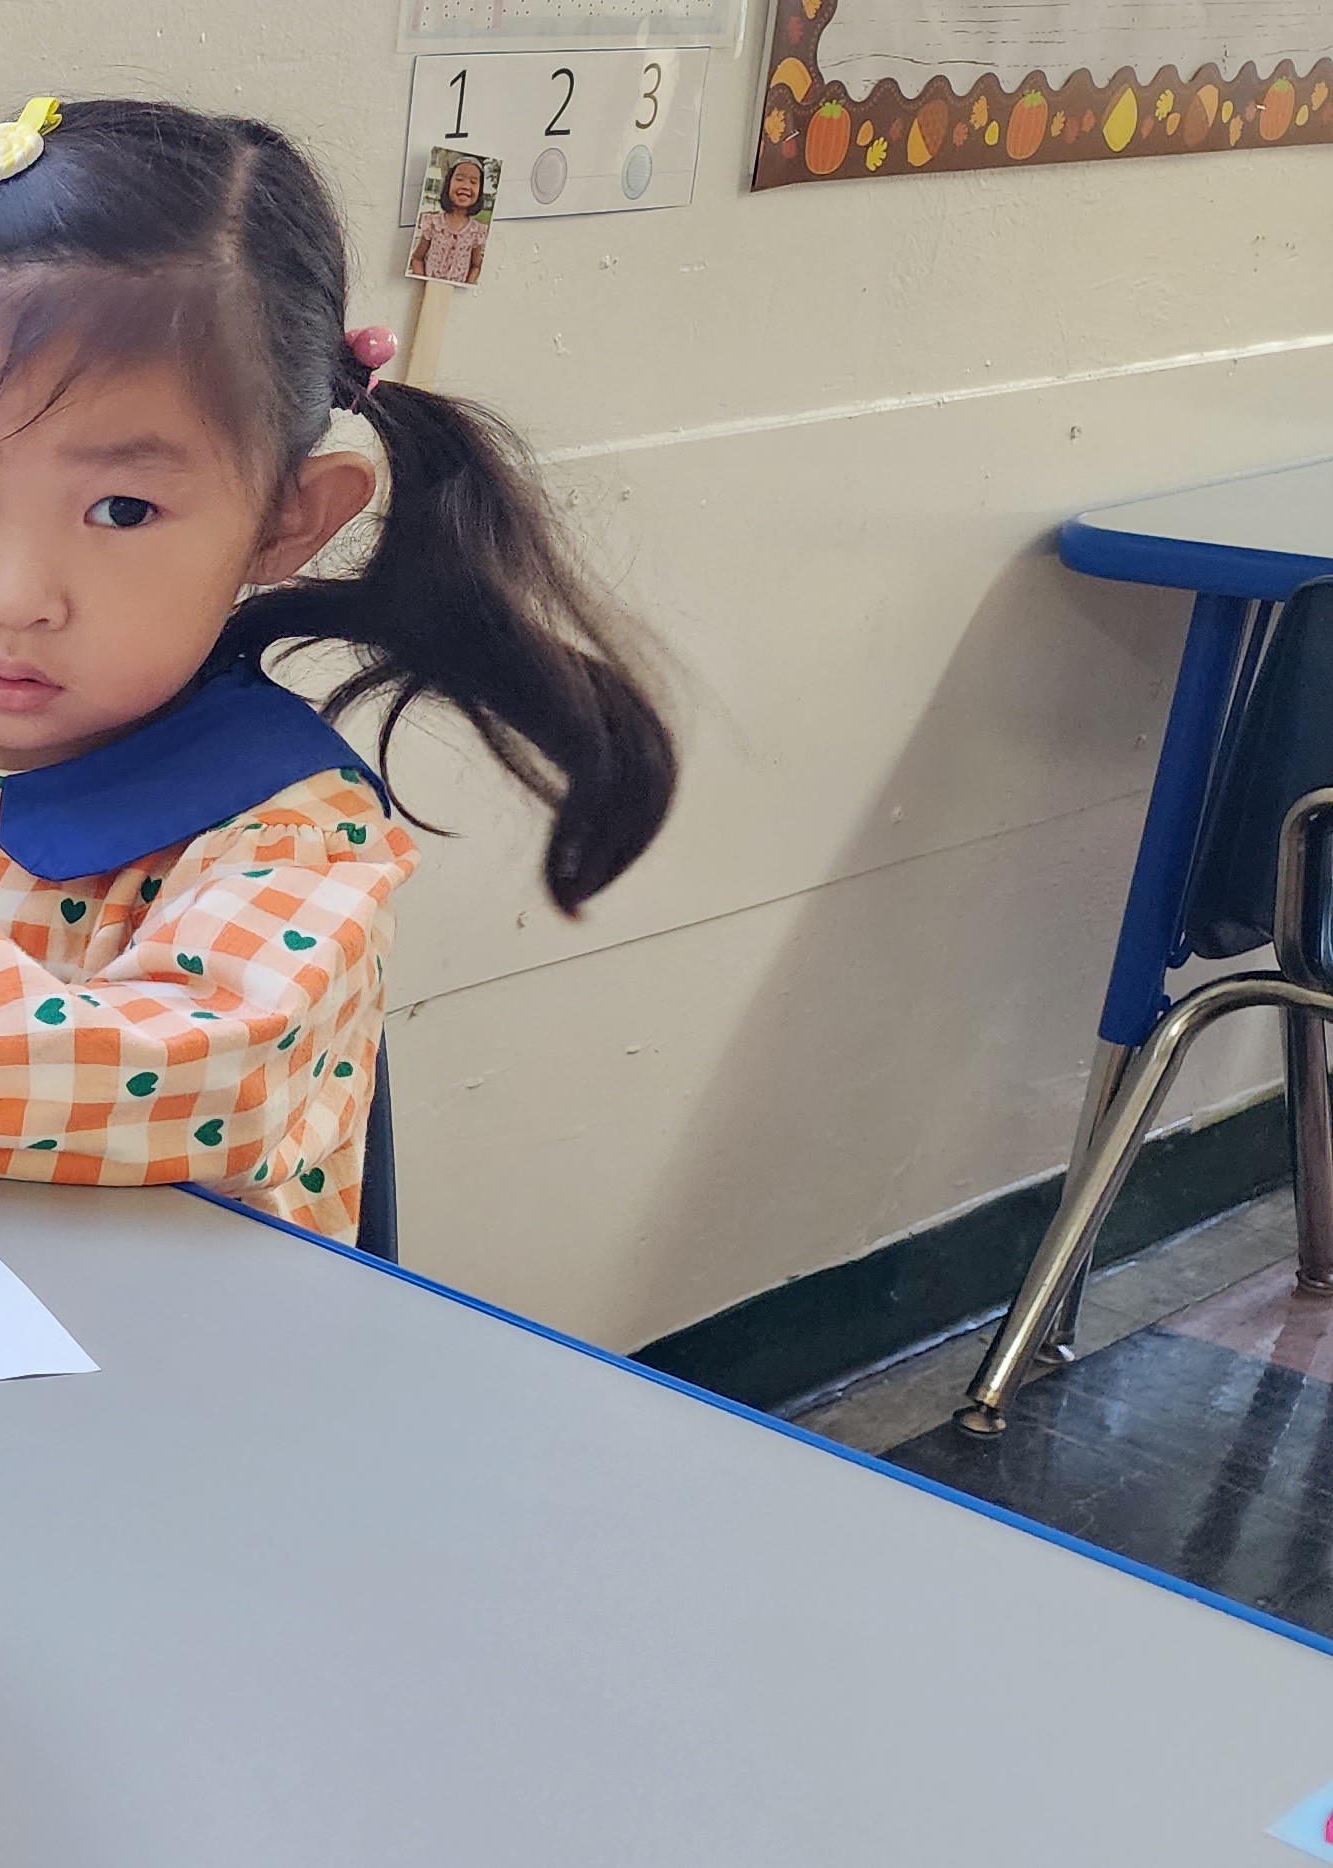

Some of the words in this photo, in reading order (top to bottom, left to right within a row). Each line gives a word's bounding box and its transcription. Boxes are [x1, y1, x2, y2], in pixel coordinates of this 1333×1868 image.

[444, 69, 469, 139] 1
[544, 67, 575, 136] 2
[635, 62, 662, 129] 3
